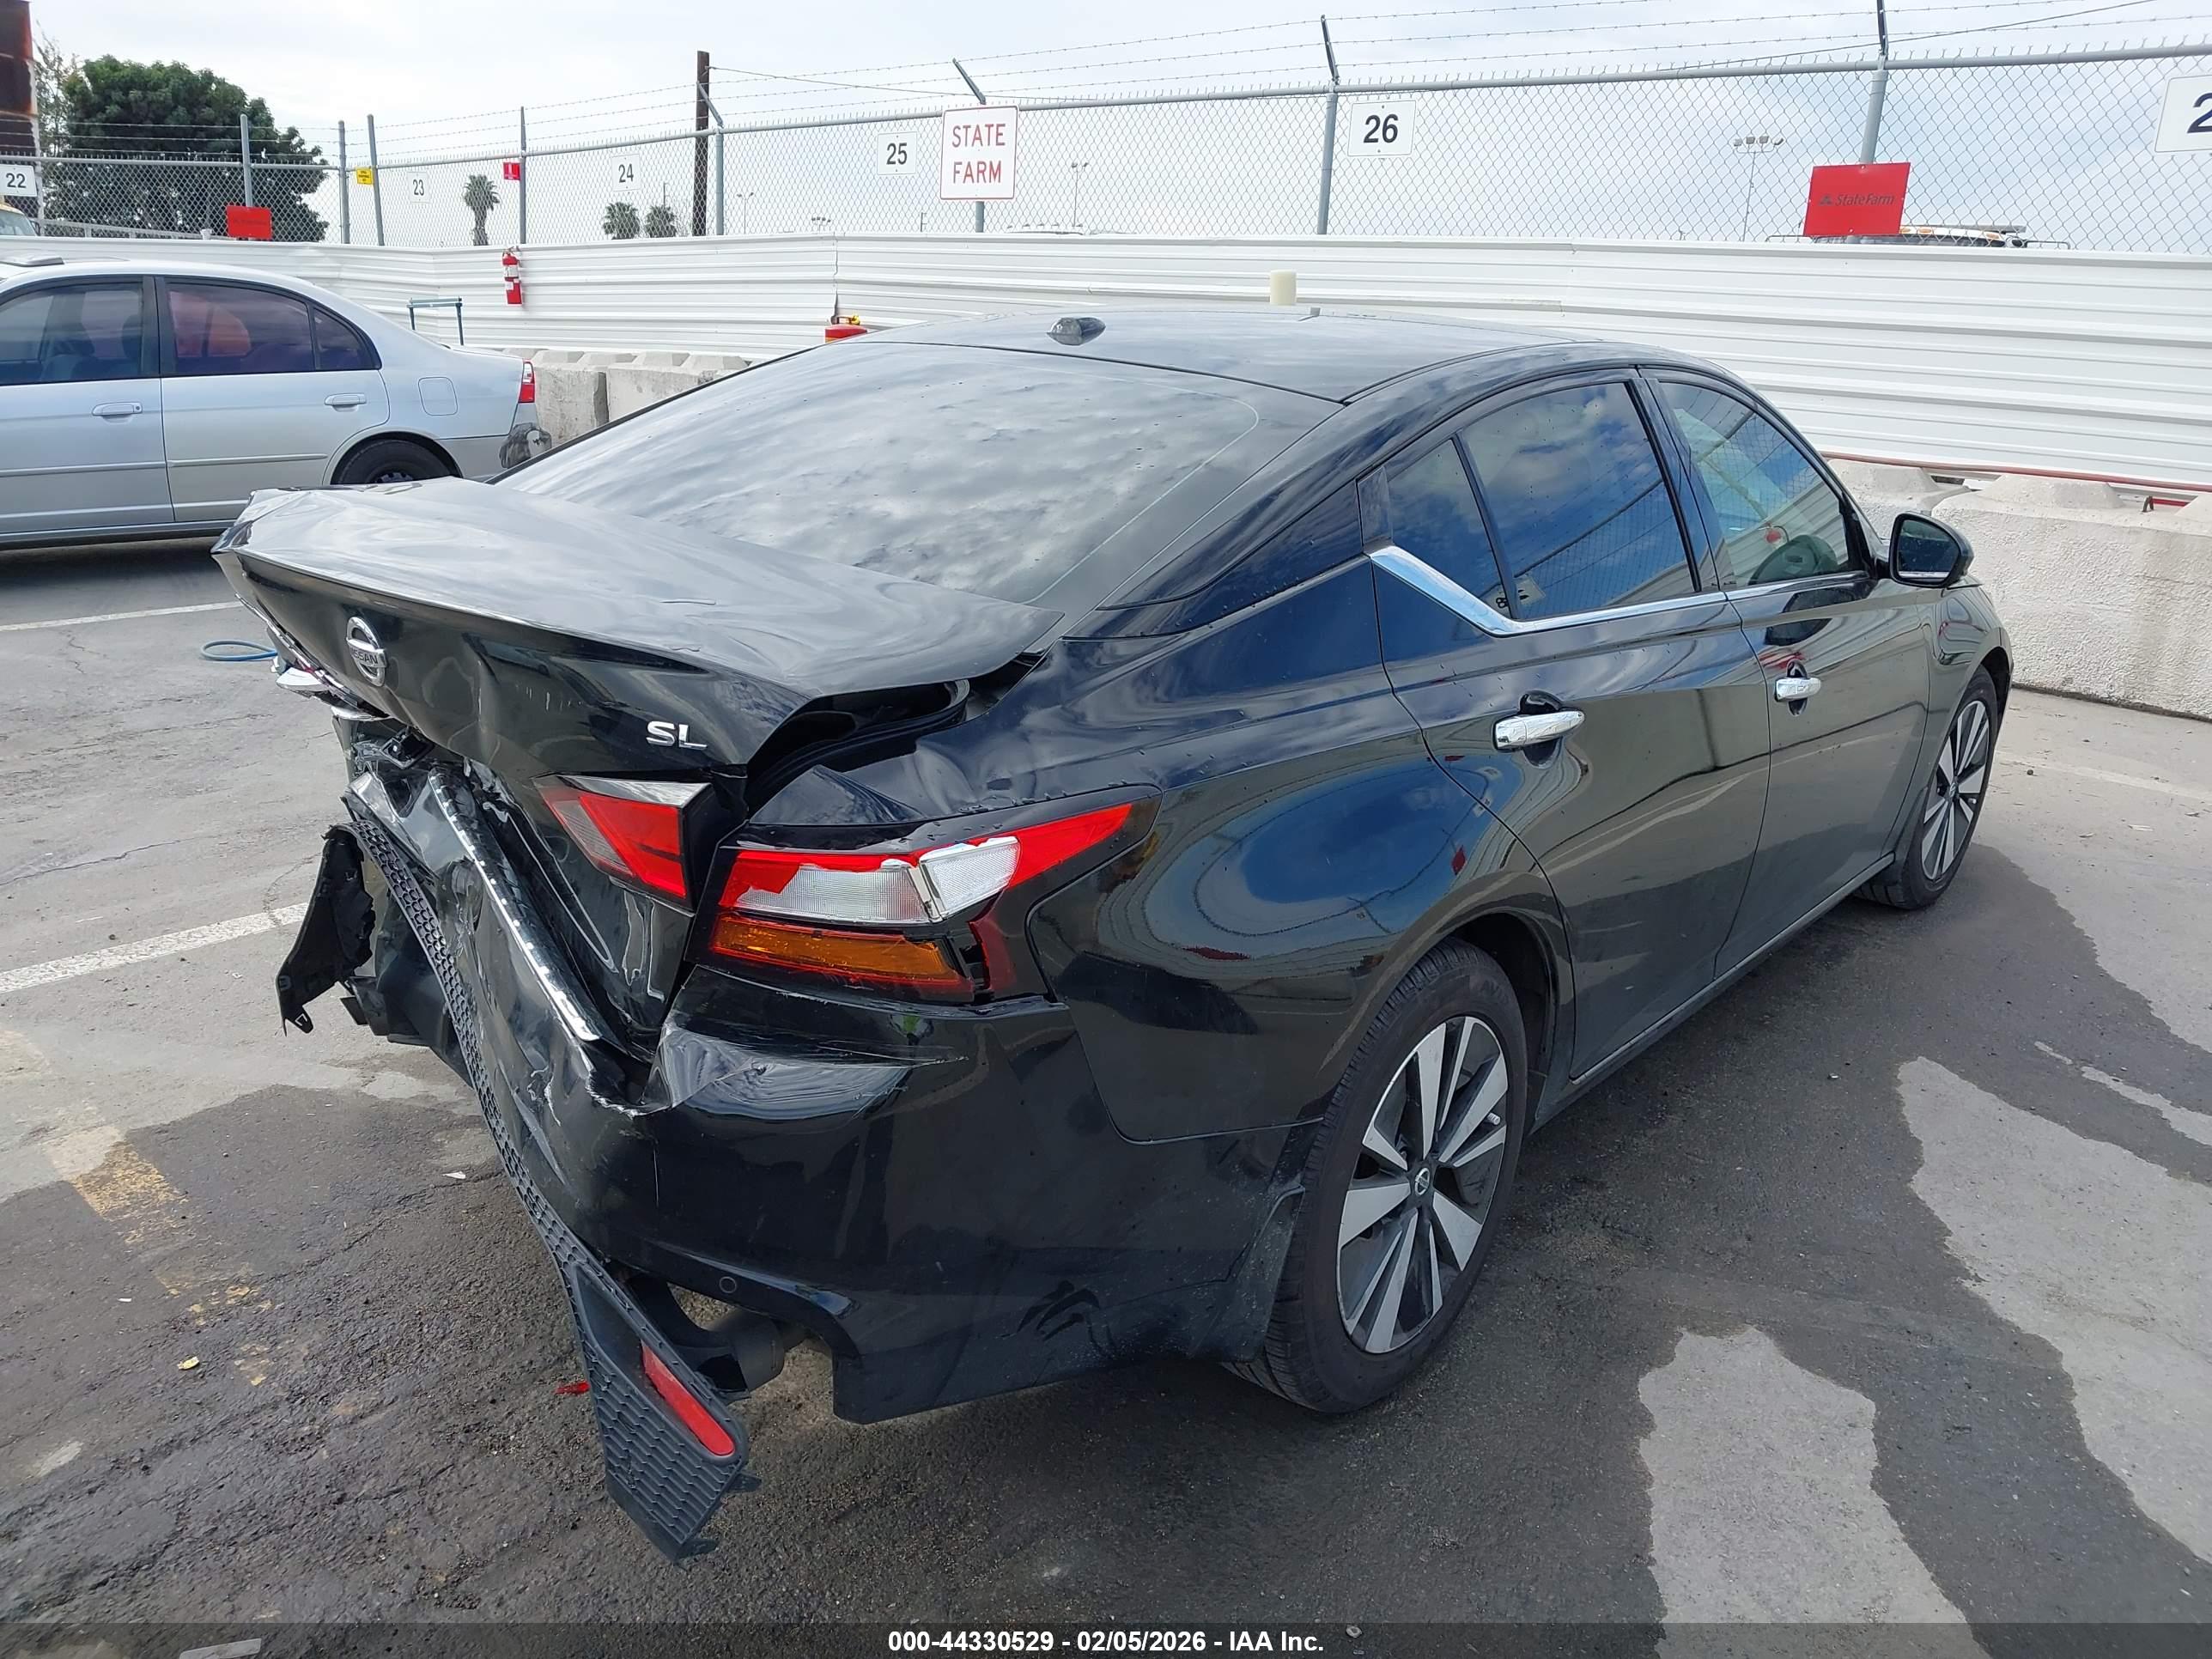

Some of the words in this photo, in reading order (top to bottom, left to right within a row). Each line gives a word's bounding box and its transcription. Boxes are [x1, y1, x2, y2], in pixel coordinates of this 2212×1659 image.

[952, 124, 1006, 148] STATE
[1364, 113, 1399, 143] 26
[886, 142, 908, 165] 25
[6, 173, 27, 188] 22
[618, 163, 634, 183] 24
[953, 160, 1001, 184] FARM
[412, 179, 425, 196] 23
[646, 720, 708, 750] SL
